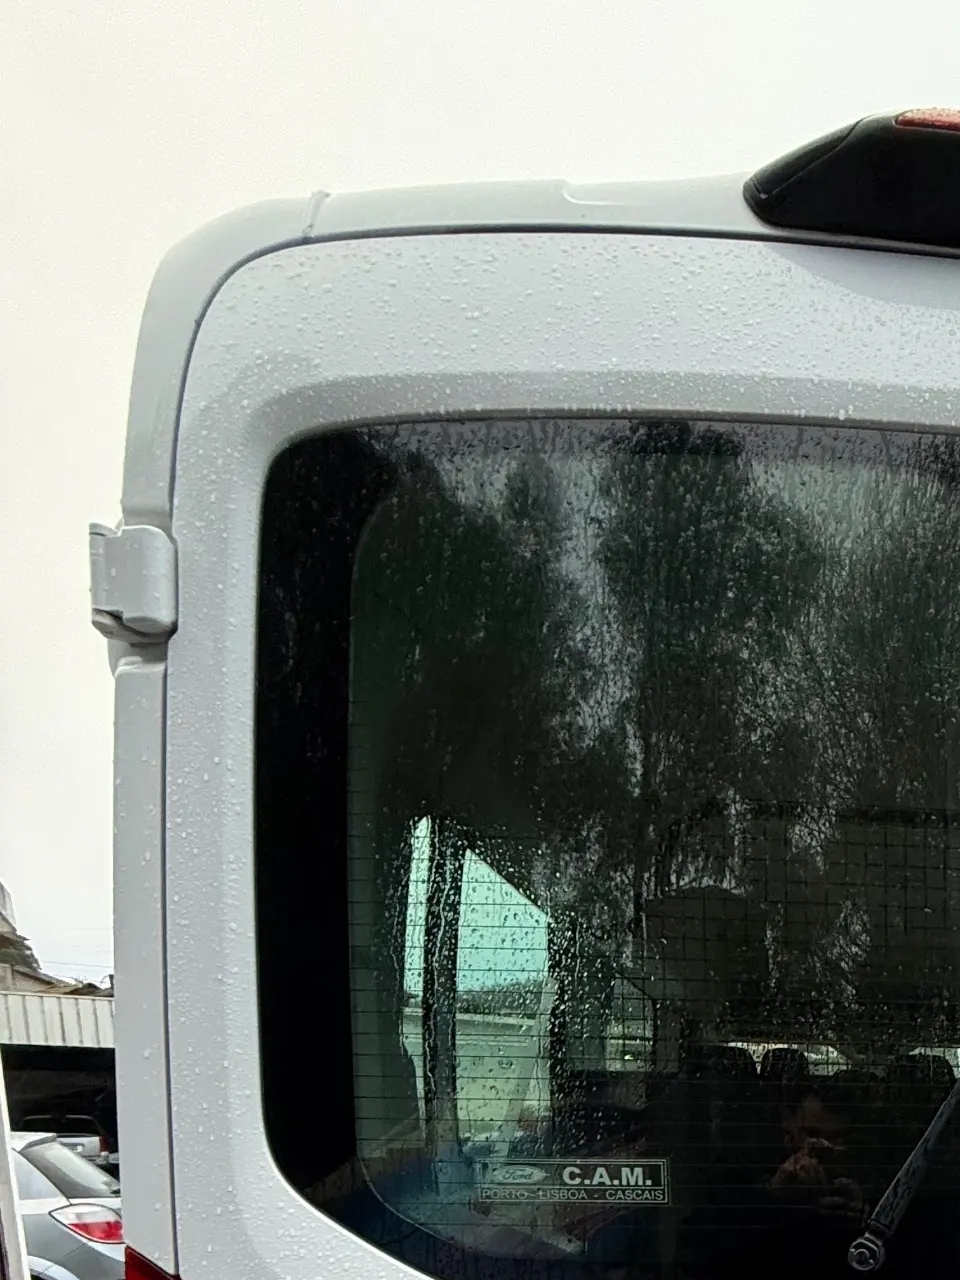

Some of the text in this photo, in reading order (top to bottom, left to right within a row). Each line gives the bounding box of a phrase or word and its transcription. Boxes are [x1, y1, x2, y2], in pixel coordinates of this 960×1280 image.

[562, 1166, 652, 1186] C.A.M.
[482, 1189, 527, 1200] PORTO
[540, 1189, 587, 1200] LISBOA
[605, 1189, 664, 1201] CASCAIS
